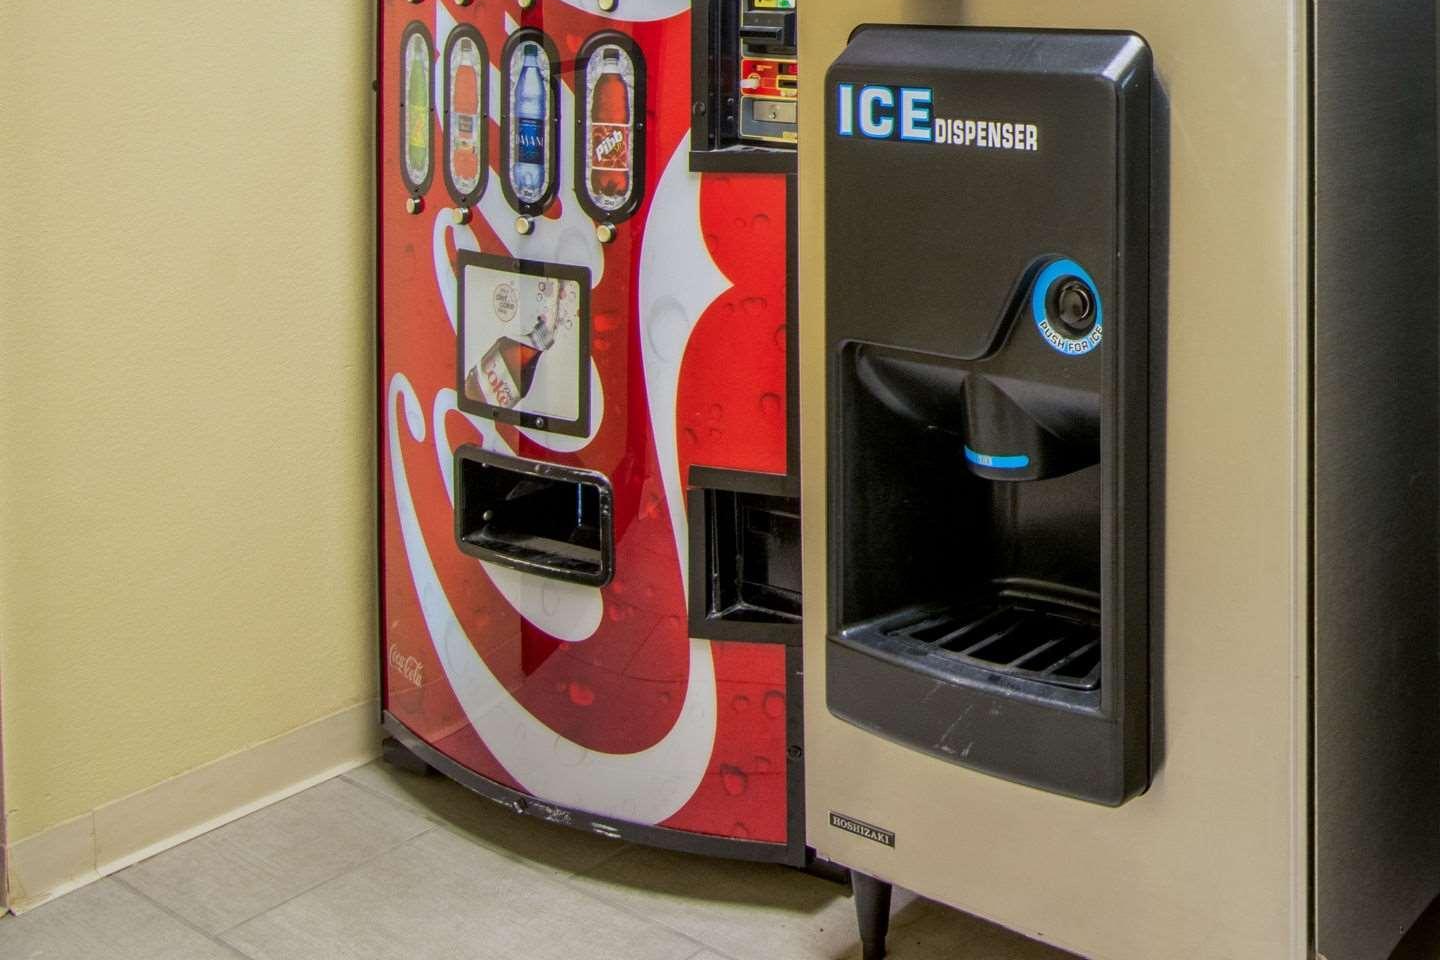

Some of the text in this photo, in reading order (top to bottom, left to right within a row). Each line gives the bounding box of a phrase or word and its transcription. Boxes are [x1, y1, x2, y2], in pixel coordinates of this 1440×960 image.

[837, 83, 1039, 151] ICE DISPENSER
[1039, 320, 1103, 352] PUSH FOR ICE
[831, 815, 890, 844] HOSHIZAKI
